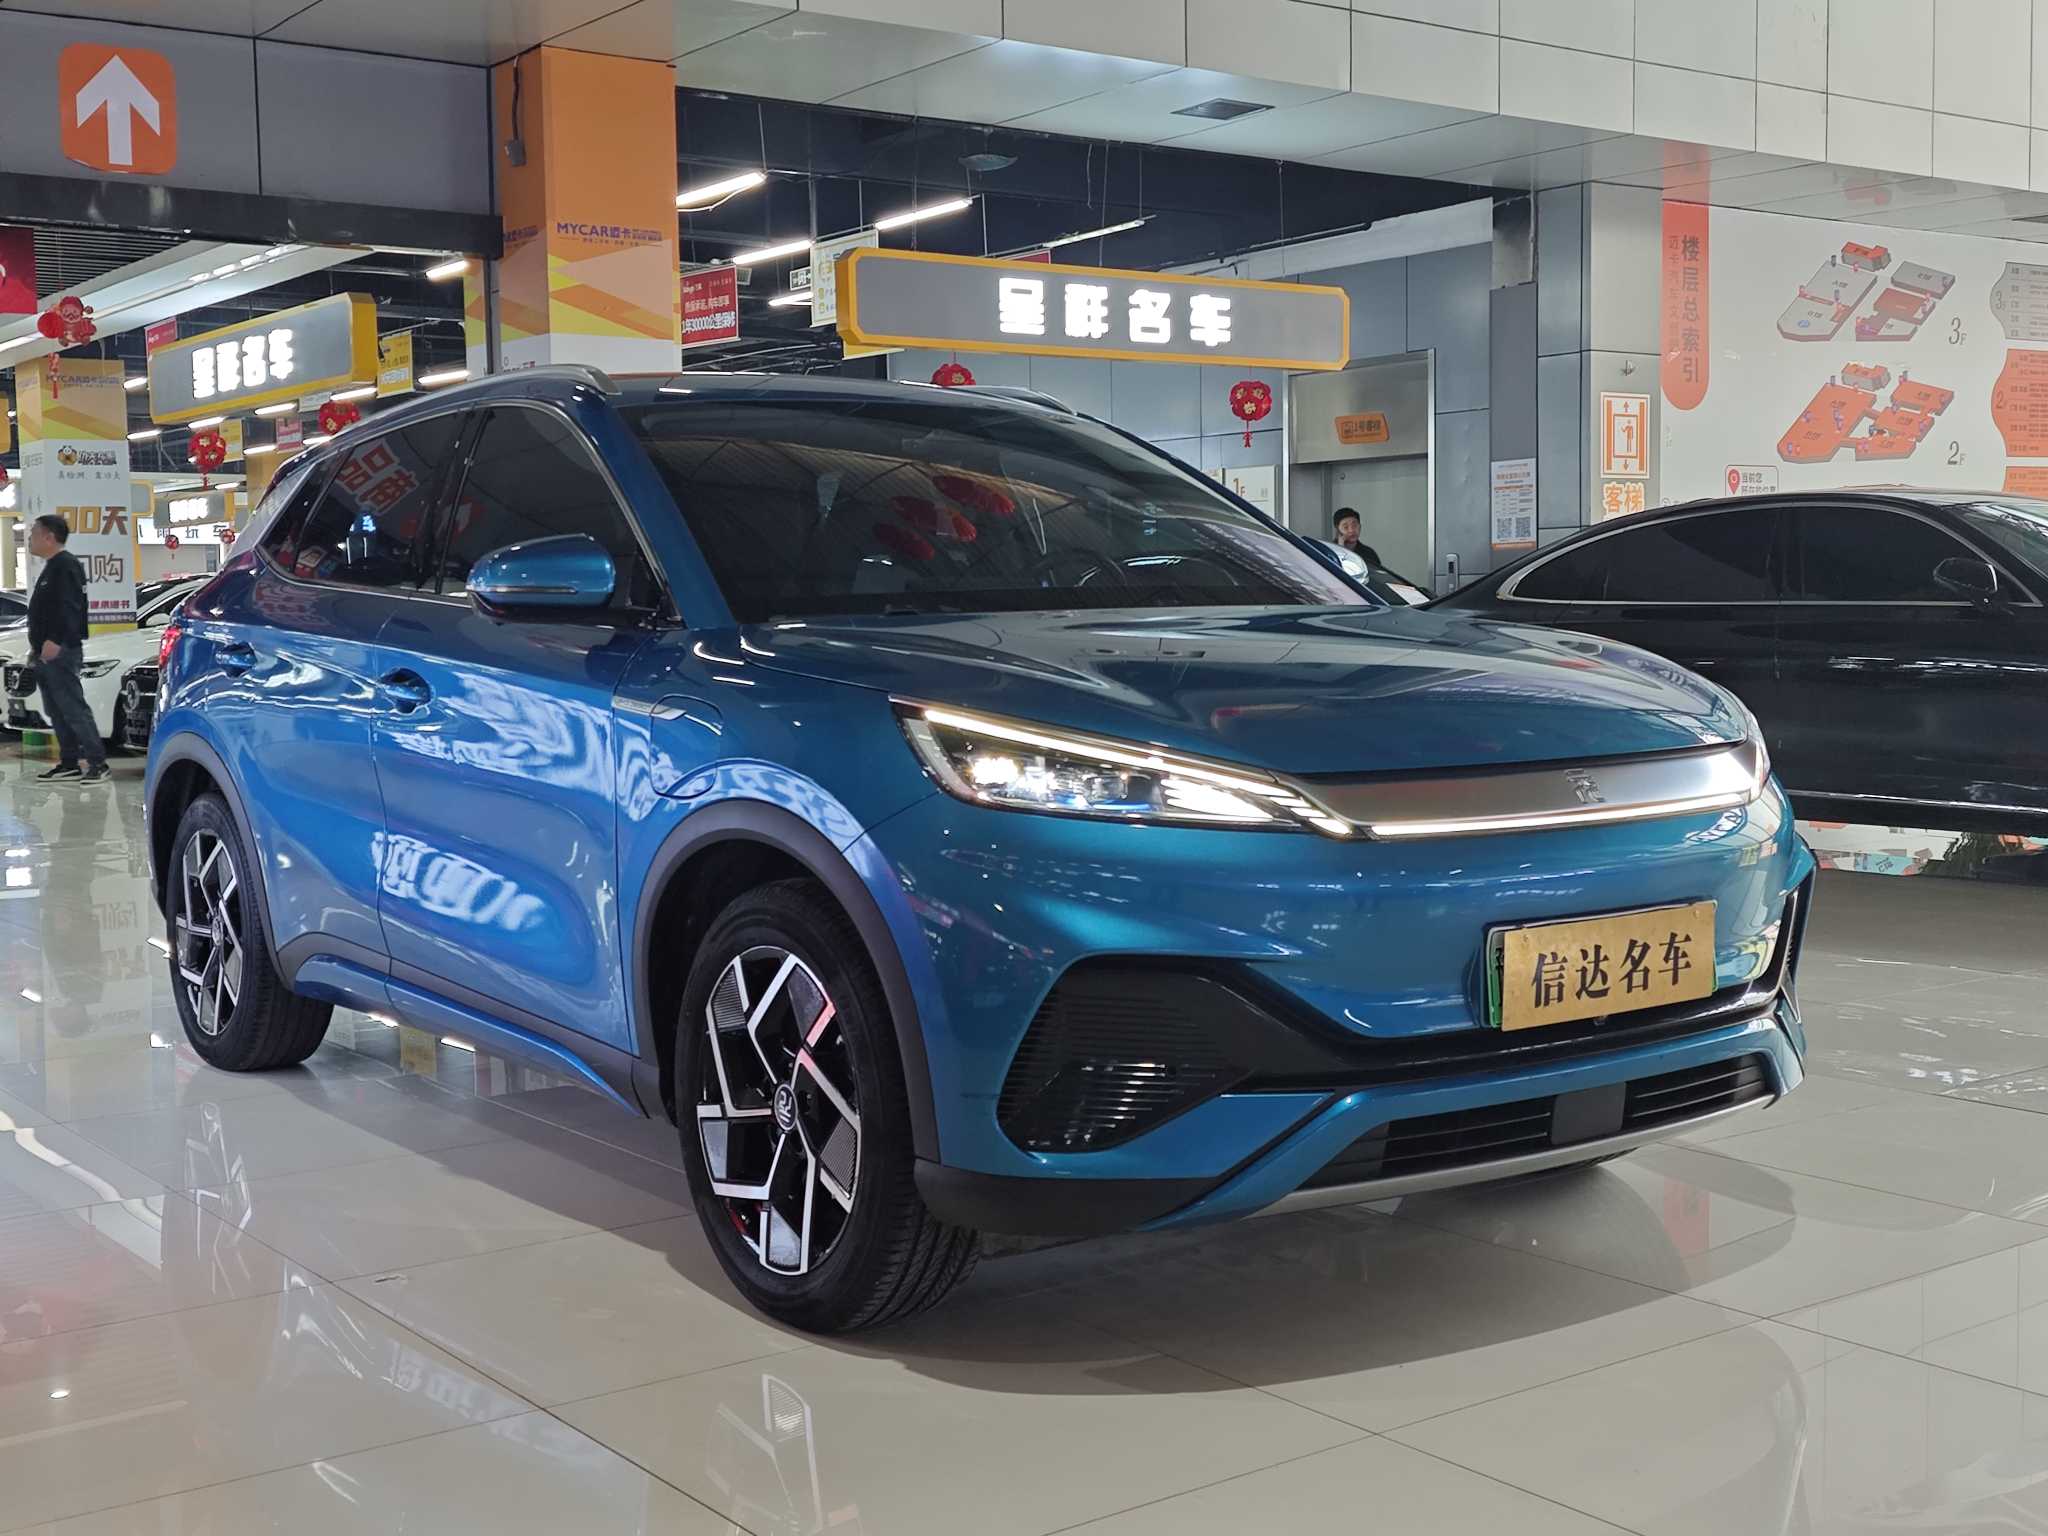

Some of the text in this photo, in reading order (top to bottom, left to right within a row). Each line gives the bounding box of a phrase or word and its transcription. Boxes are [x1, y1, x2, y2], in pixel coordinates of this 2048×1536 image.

[1681, 234, 1700, 383] 楼层总索引
[1532, 931, 1693, 1008] 信达名车
